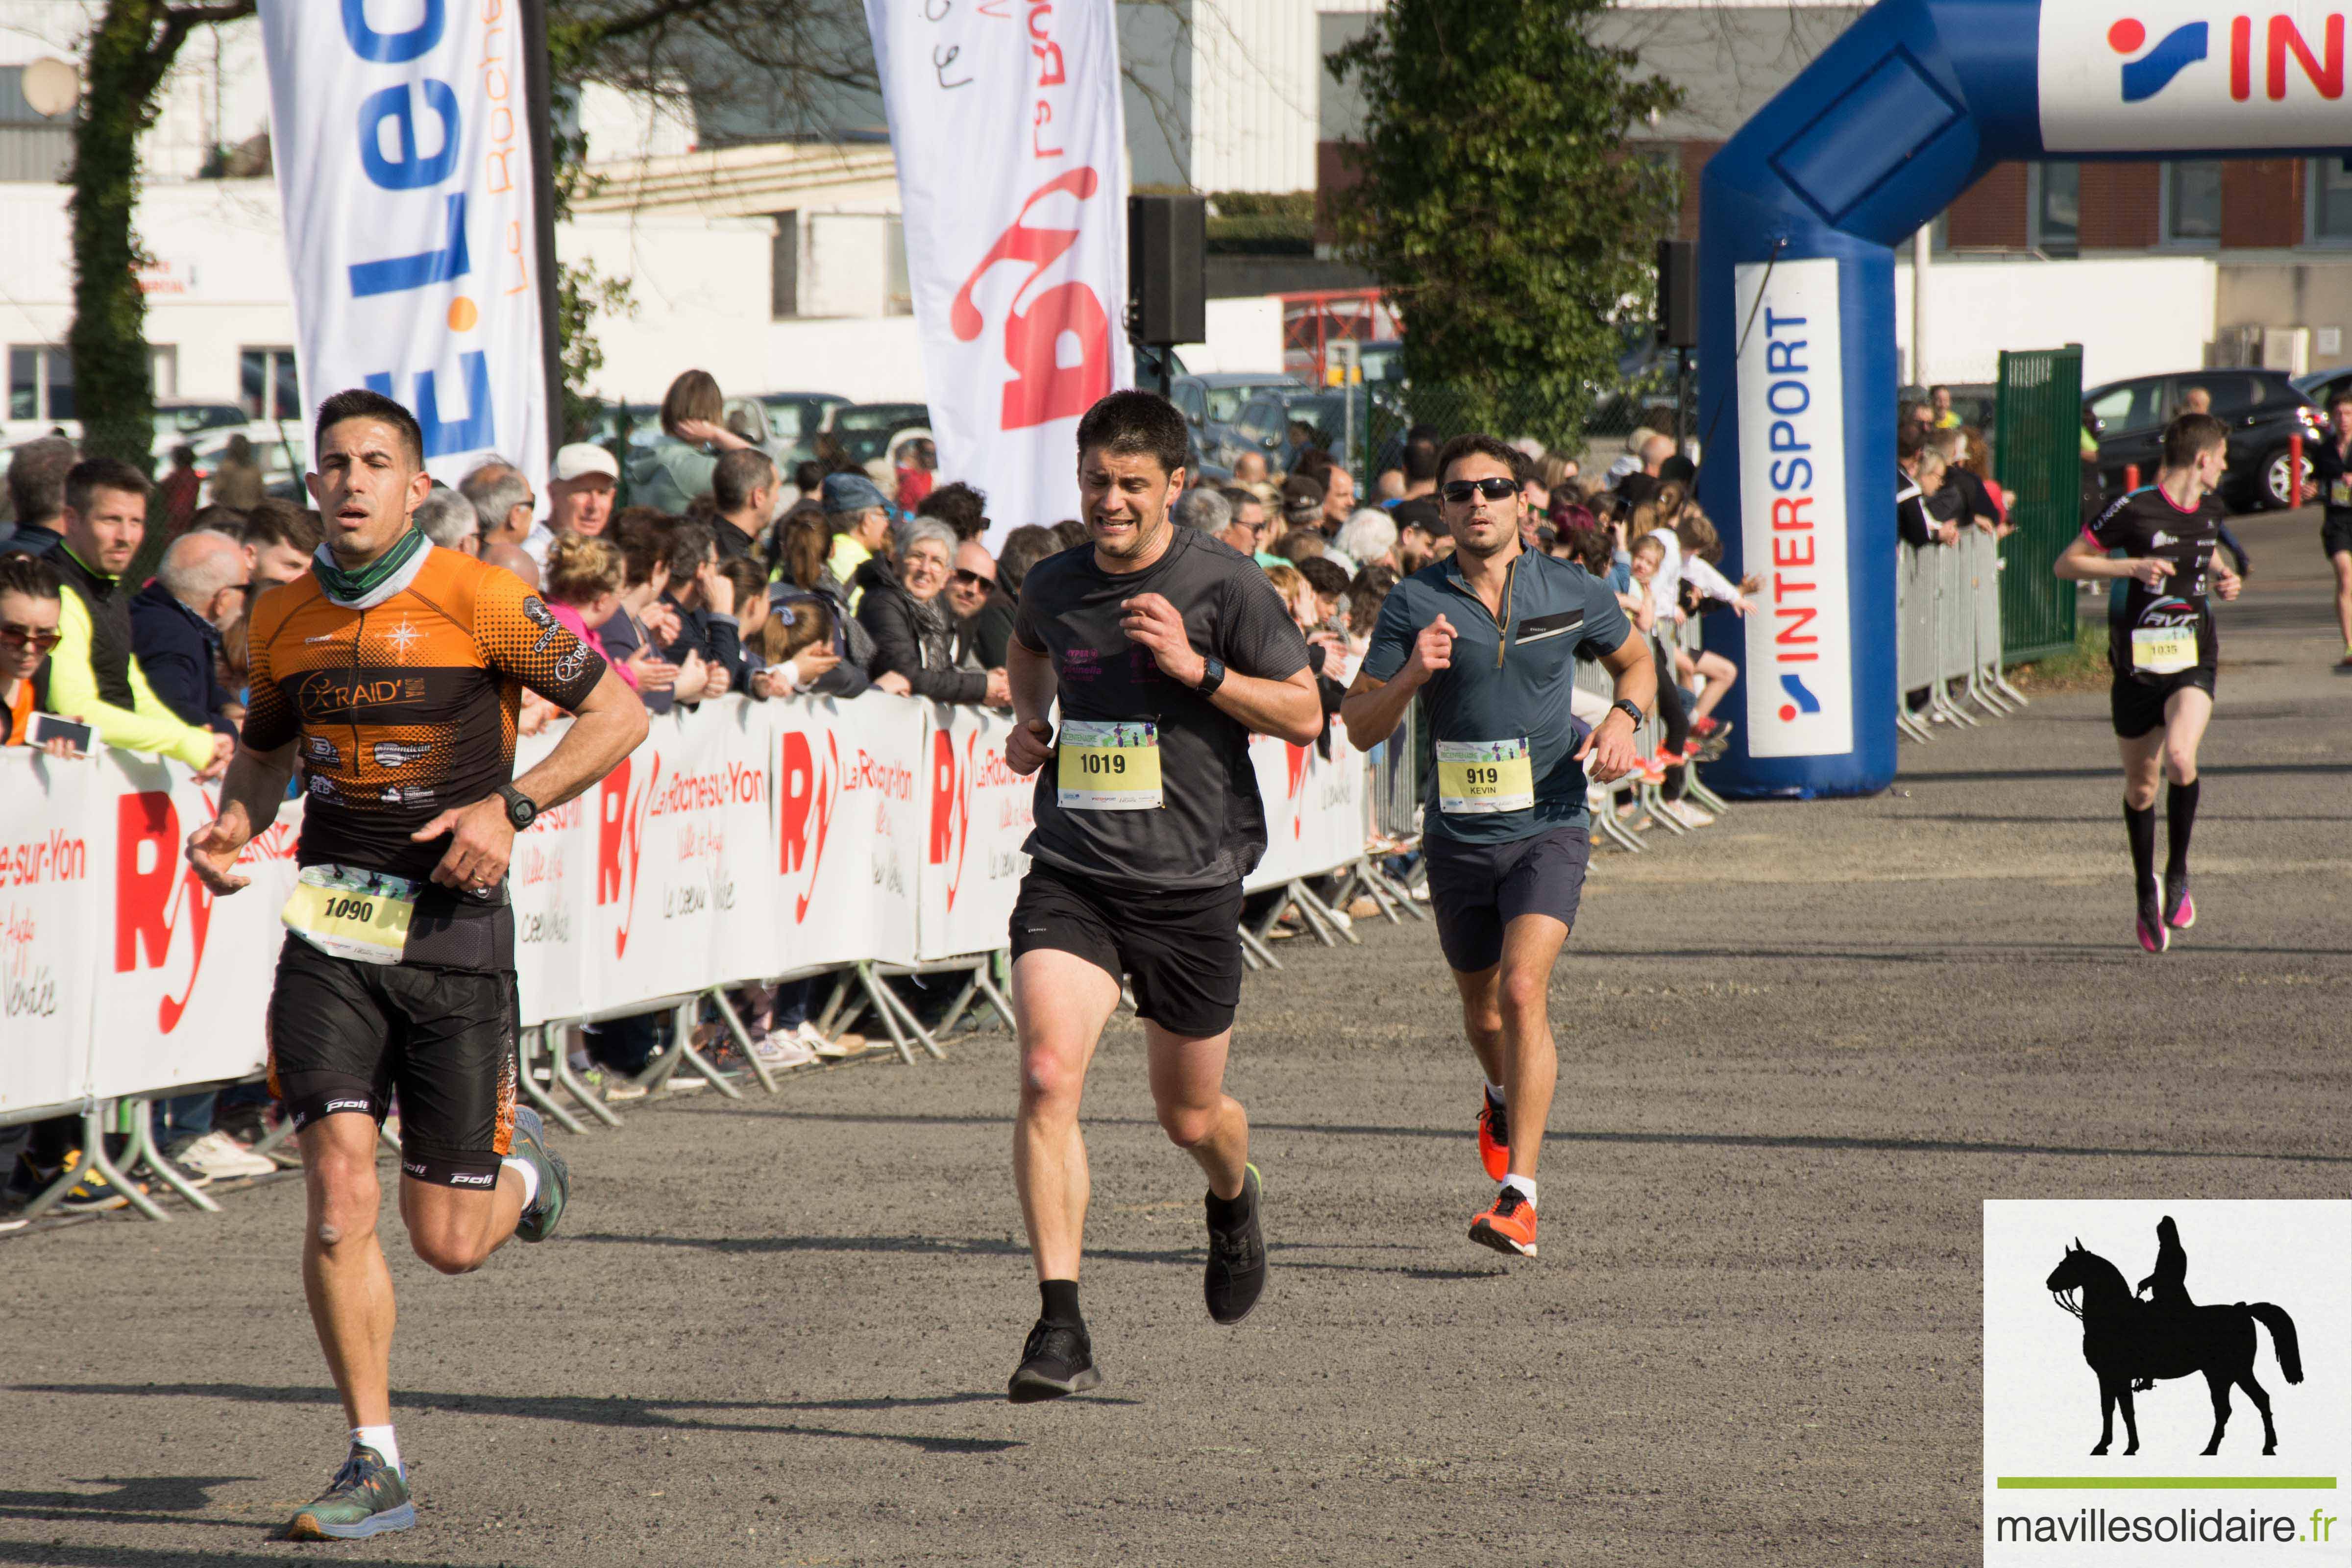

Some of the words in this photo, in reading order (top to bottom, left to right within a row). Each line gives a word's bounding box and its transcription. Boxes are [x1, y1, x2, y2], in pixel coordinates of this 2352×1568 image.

[1766, 307, 1819, 662] INTERSPORT
[1081, 754, 1126, 774] 1019
[1467, 768, 1497, 784] 919
[324, 897, 373, 922] 1090
[326, 1099, 368, 1112] poli
[450, 1174, 493, 1185] poli
